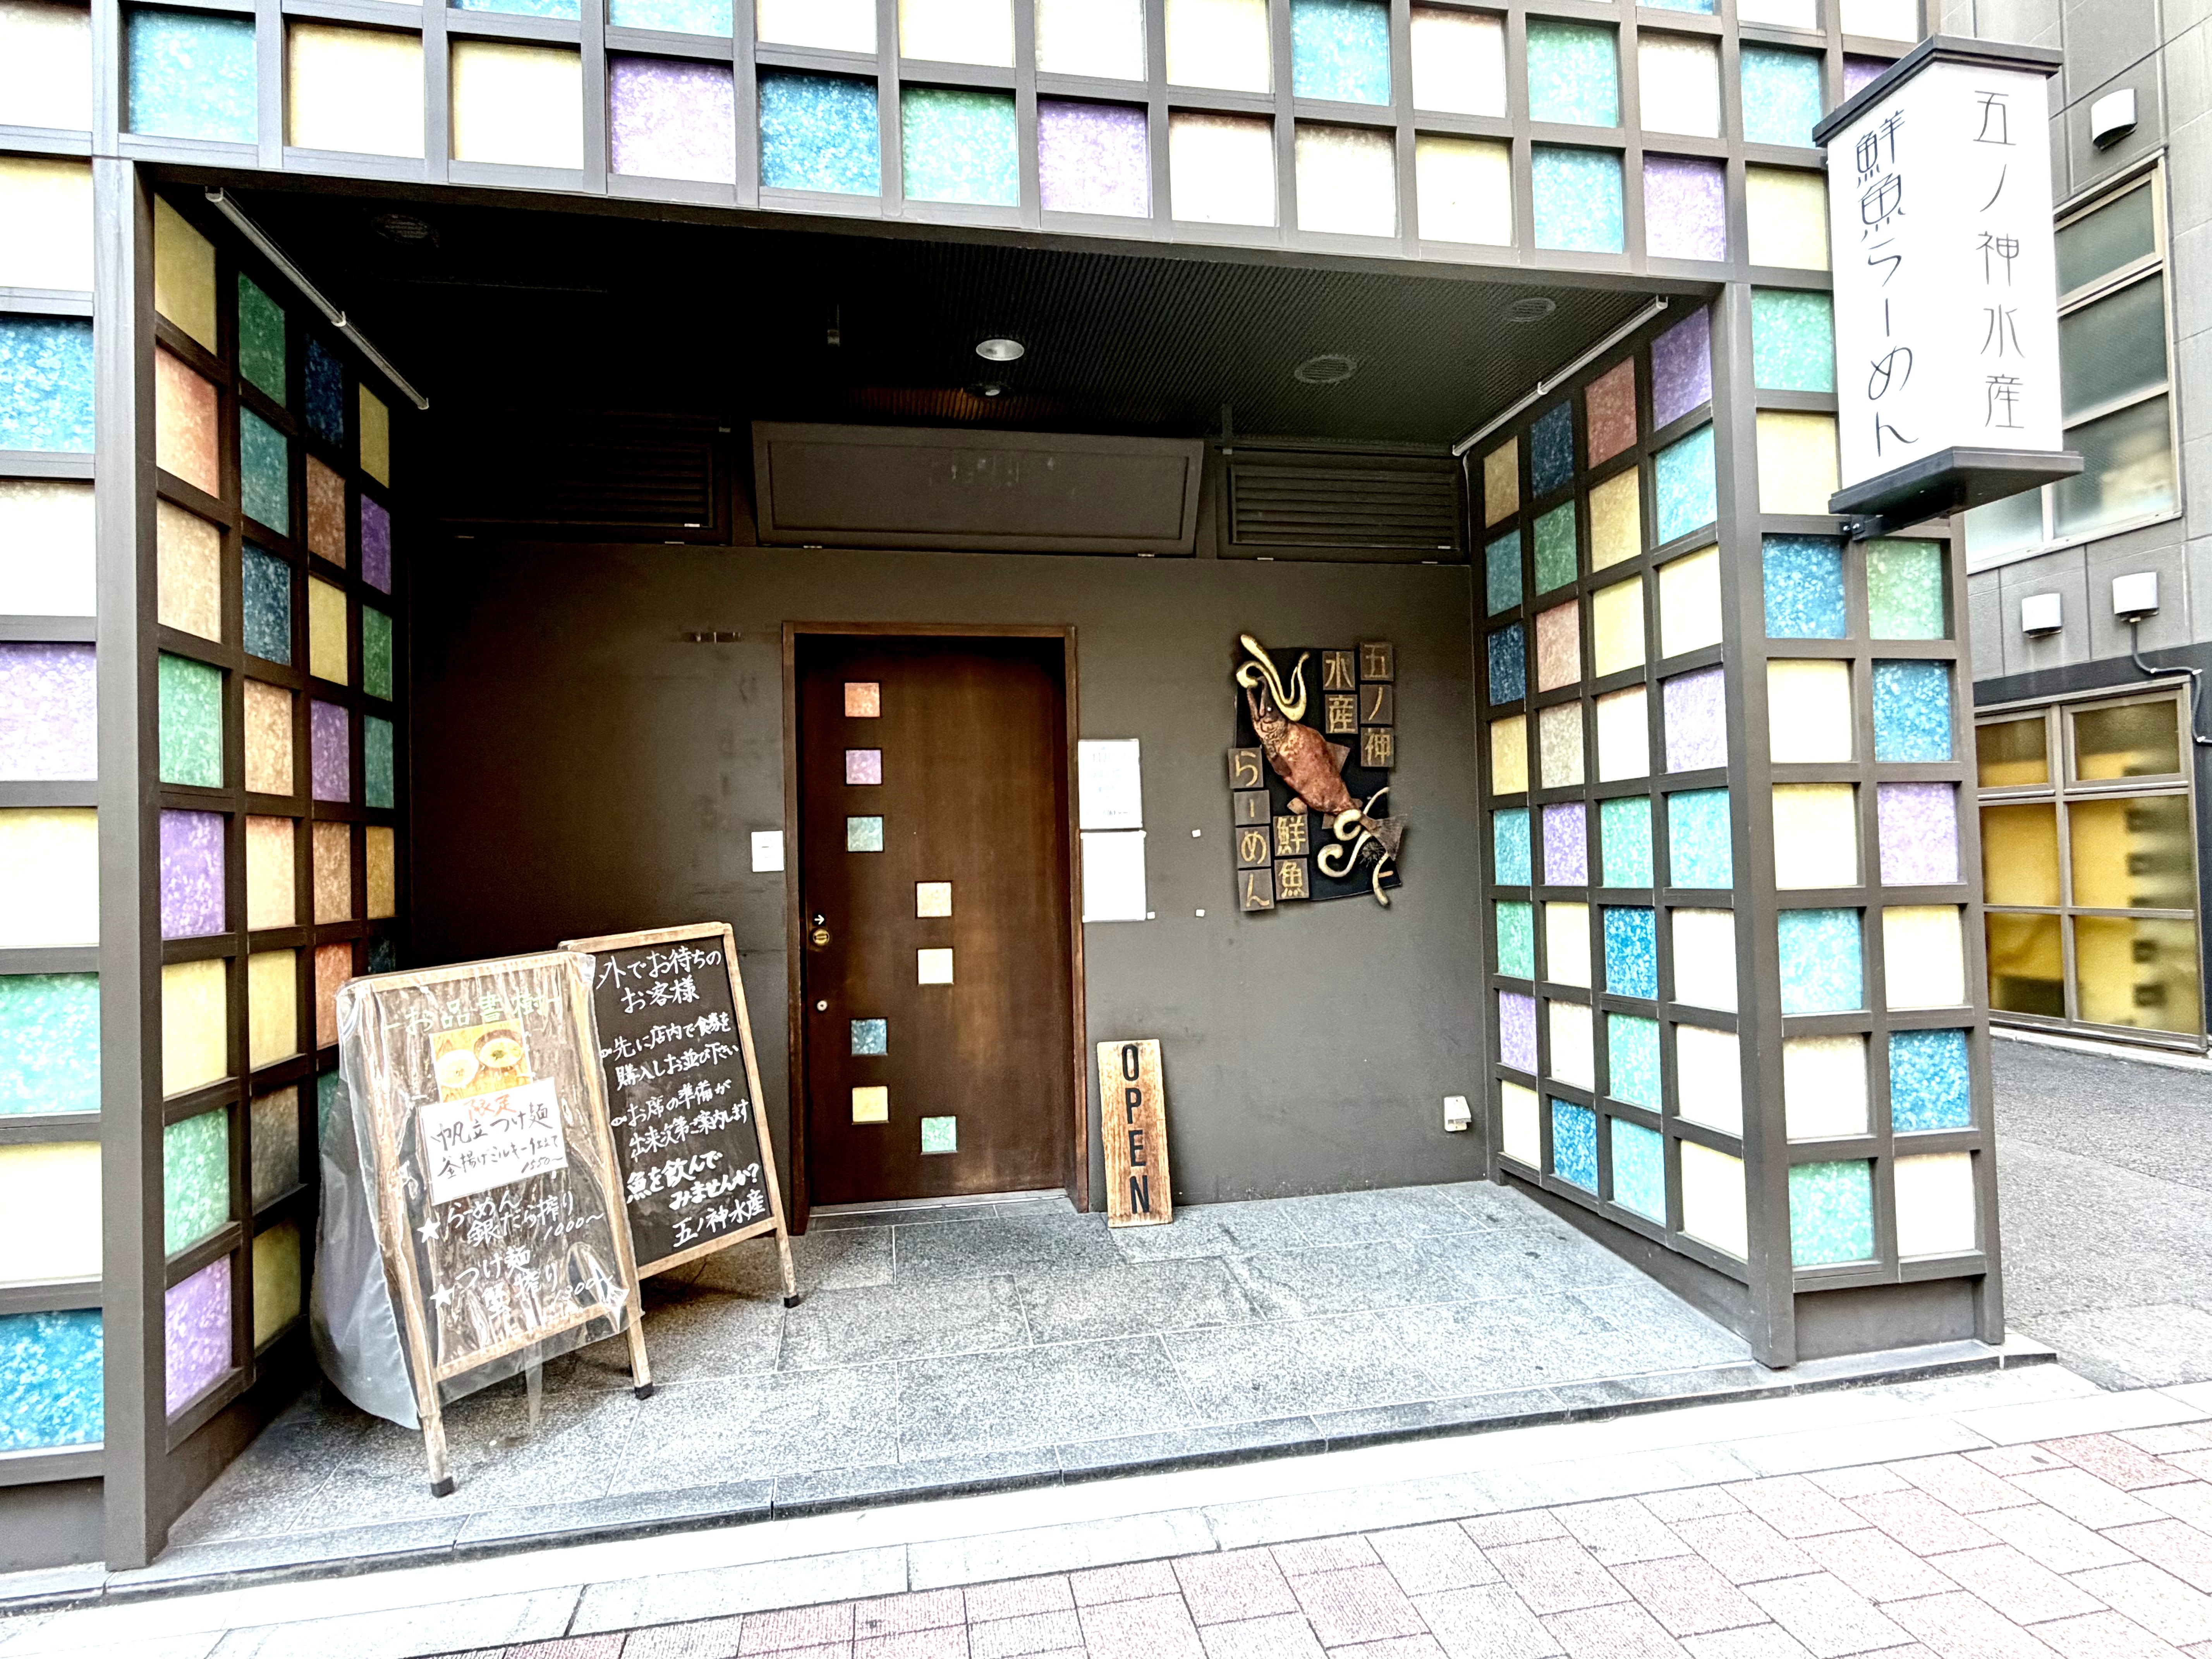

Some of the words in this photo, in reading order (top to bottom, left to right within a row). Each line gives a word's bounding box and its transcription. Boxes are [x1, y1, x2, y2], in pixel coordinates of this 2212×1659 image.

[1855, 109, 1918, 457] 鮮魚らーめん
[1973, 90, 2025, 429] 五ノ神水産
[1325, 652, 1354, 733] 水産
[1235, 751, 1270, 907] らーめん
[1277, 816, 1307, 898] 鮮魚
[596, 946, 721, 989] 外でお待ちの
[621, 975, 700, 1013] お客様
[613, 1012, 731, 1061] 先に店内で食券を
[615, 1042, 739, 1091] 購入しお並び下さい
[430, 1102, 553, 1151] 帆立つけ麺
[463, 1094, 517, 1121] 限定
[627, 1079, 732, 1127] お席の準備が
[1122, 1045, 1149, 1215] OPEN
[627, 1151, 723, 1204] 魚を飲んで
[448, 1190, 520, 1228] らーめん
[672, 1189, 765, 1247] 五ノ神水産
[455, 1245, 531, 1288] つけ麺
